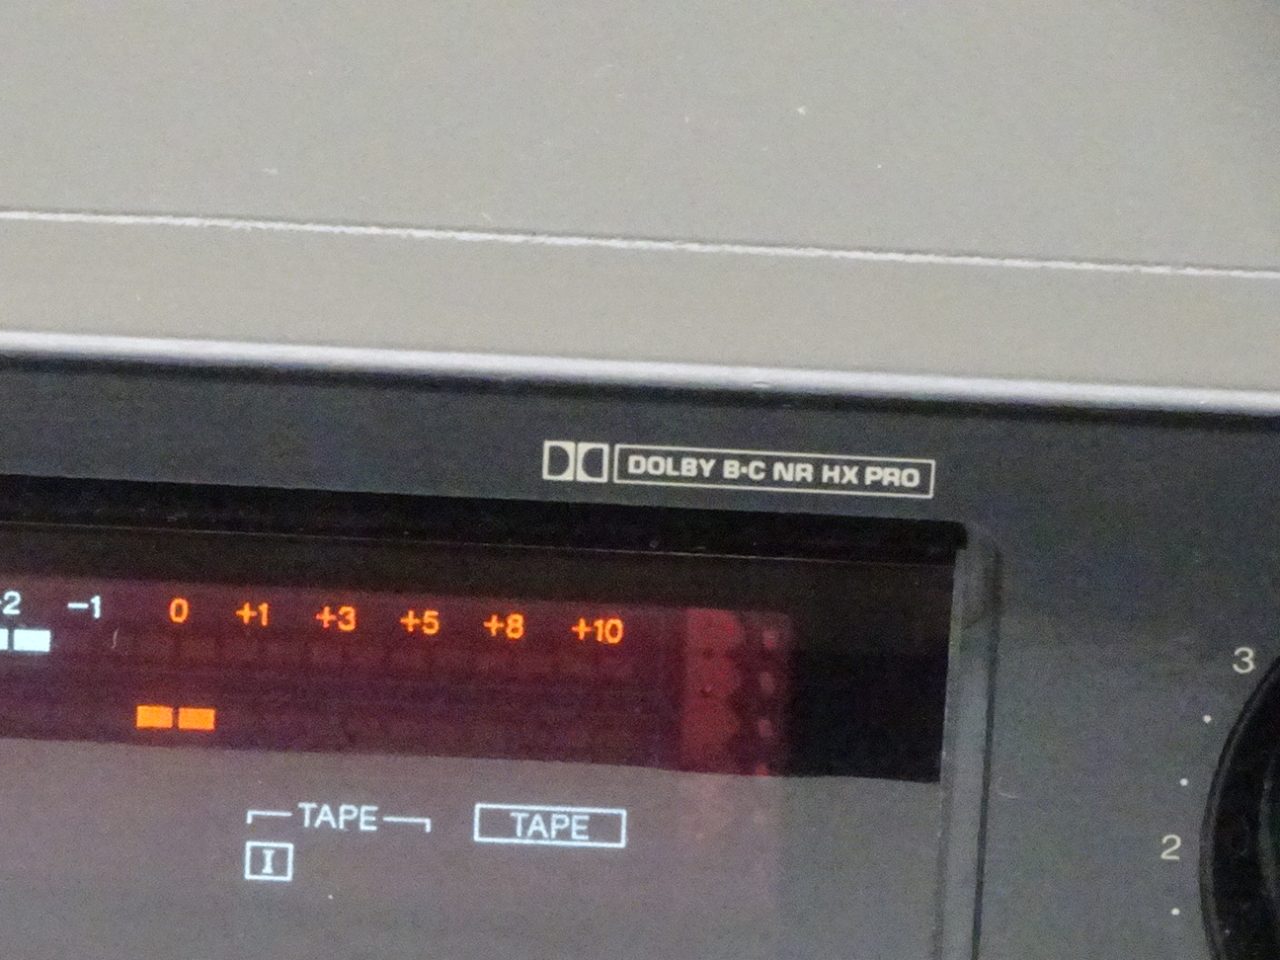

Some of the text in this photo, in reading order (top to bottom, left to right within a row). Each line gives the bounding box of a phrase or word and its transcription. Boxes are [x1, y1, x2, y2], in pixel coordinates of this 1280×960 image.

[629, 454, 716, 480] DOLBY
[773, 461, 814, 483] NR
[822, 464, 859, 485] HX
[864, 466, 920, 488] PRO
[169, 597, 189, 623] 0
[235, 602, 269, 627] +1
[315, 605, 356, 632] +3
[400, 609, 440, 635] +5
[483, 613, 524, 640] +8
[571, 617, 624, 644] +10
[1232, 646, 1255, 674] 3
[298, 802, 378, 831] TAPE
[511, 812, 589, 842] TAPE
[1160, 834, 1182, 860] 2
